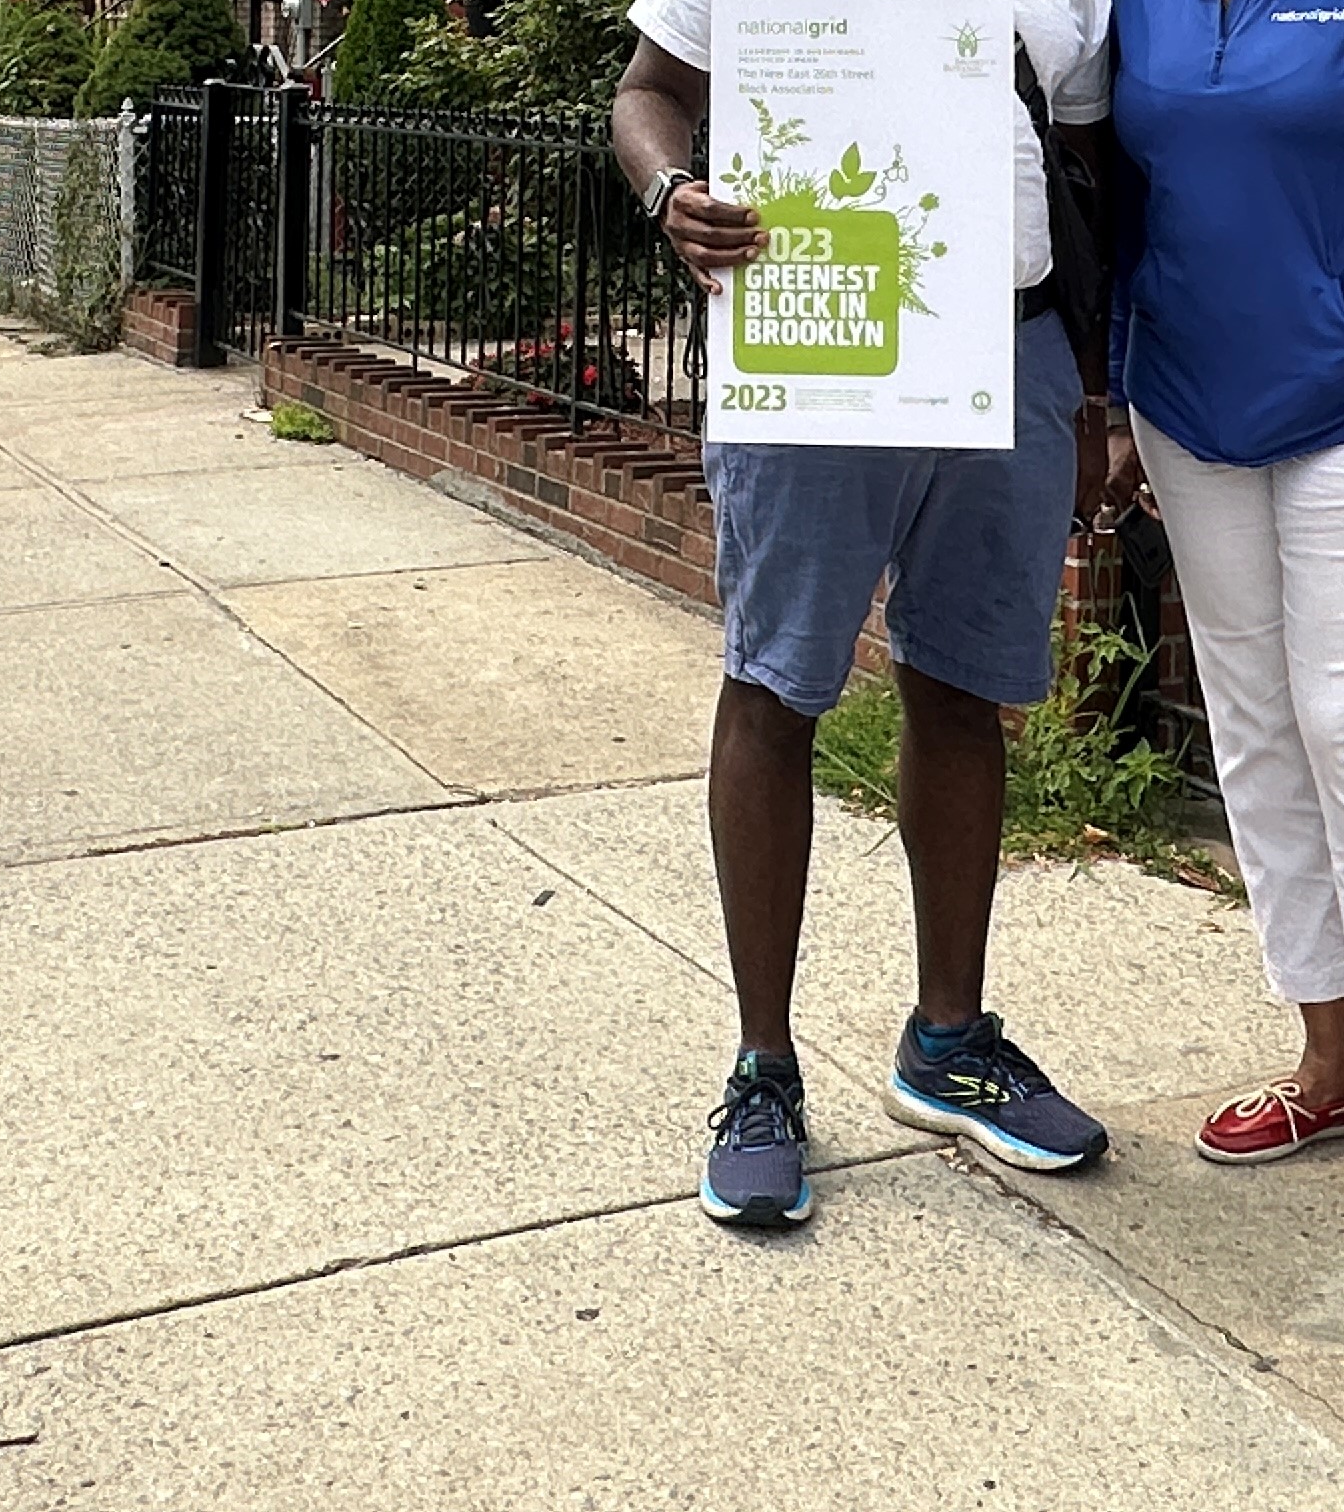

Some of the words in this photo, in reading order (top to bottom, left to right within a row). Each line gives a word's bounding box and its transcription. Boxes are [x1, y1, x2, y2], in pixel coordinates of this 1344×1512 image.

[738, 17, 847, 39] nationalgrid
[756, 226, 833, 262] 023
[745, 264, 881, 292] GREENEST
[745, 290, 831, 319] BLOCK
[839, 292, 867, 319] IN
[745, 318, 884, 348] BROOKLYN
[721, 384, 787, 411] 2023
